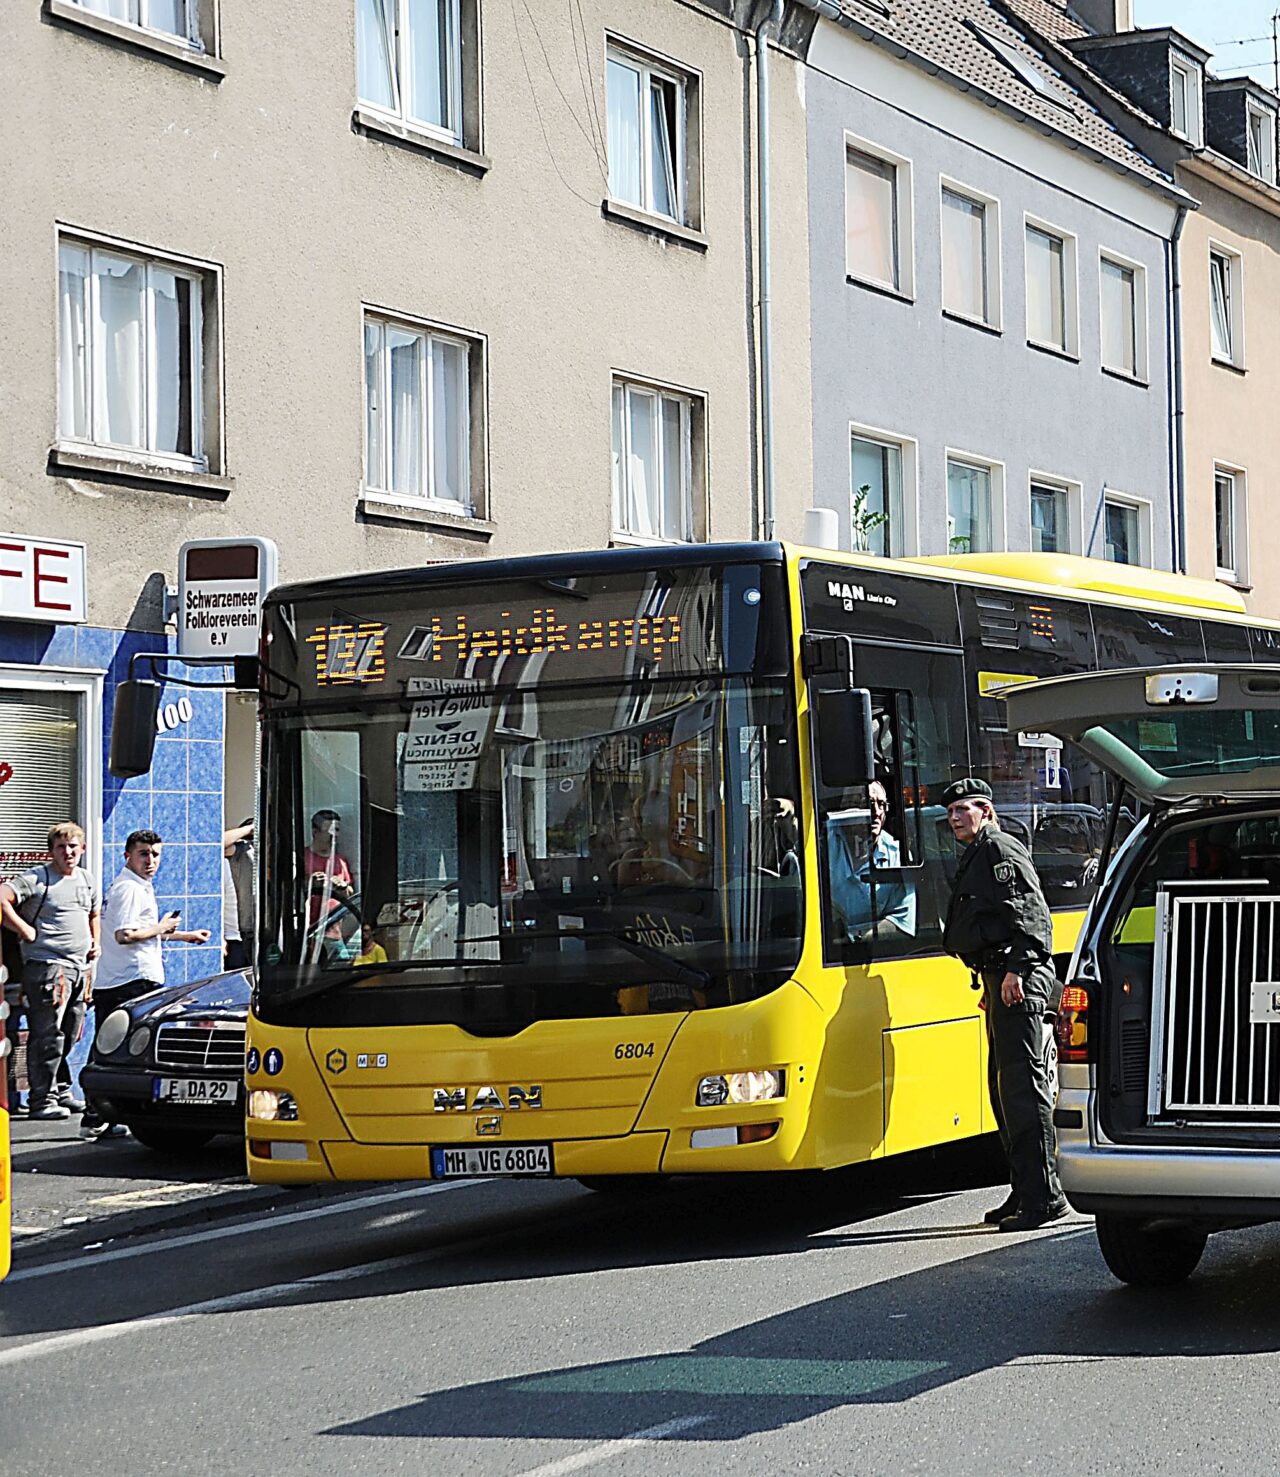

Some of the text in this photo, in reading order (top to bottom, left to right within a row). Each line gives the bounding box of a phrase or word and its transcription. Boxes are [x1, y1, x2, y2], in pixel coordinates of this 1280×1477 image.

[186, 590, 258, 609] Schwarzemeer
[828, 582, 865, 600] MAN
[186, 609, 258, 630] Folkloreverein
[210, 631, 227, 646] e.v
[432, 608, 682, 662] Heidkamp
[613, 1043, 655, 1060] 6804
[357, 1054, 387, 1068] MVG
[169, 1080, 179, 1096] E
[209, 1081, 228, 1098] 29
[433, 1085, 543, 1112] MAN
[444, 1147, 547, 1173] MH VG 6804
